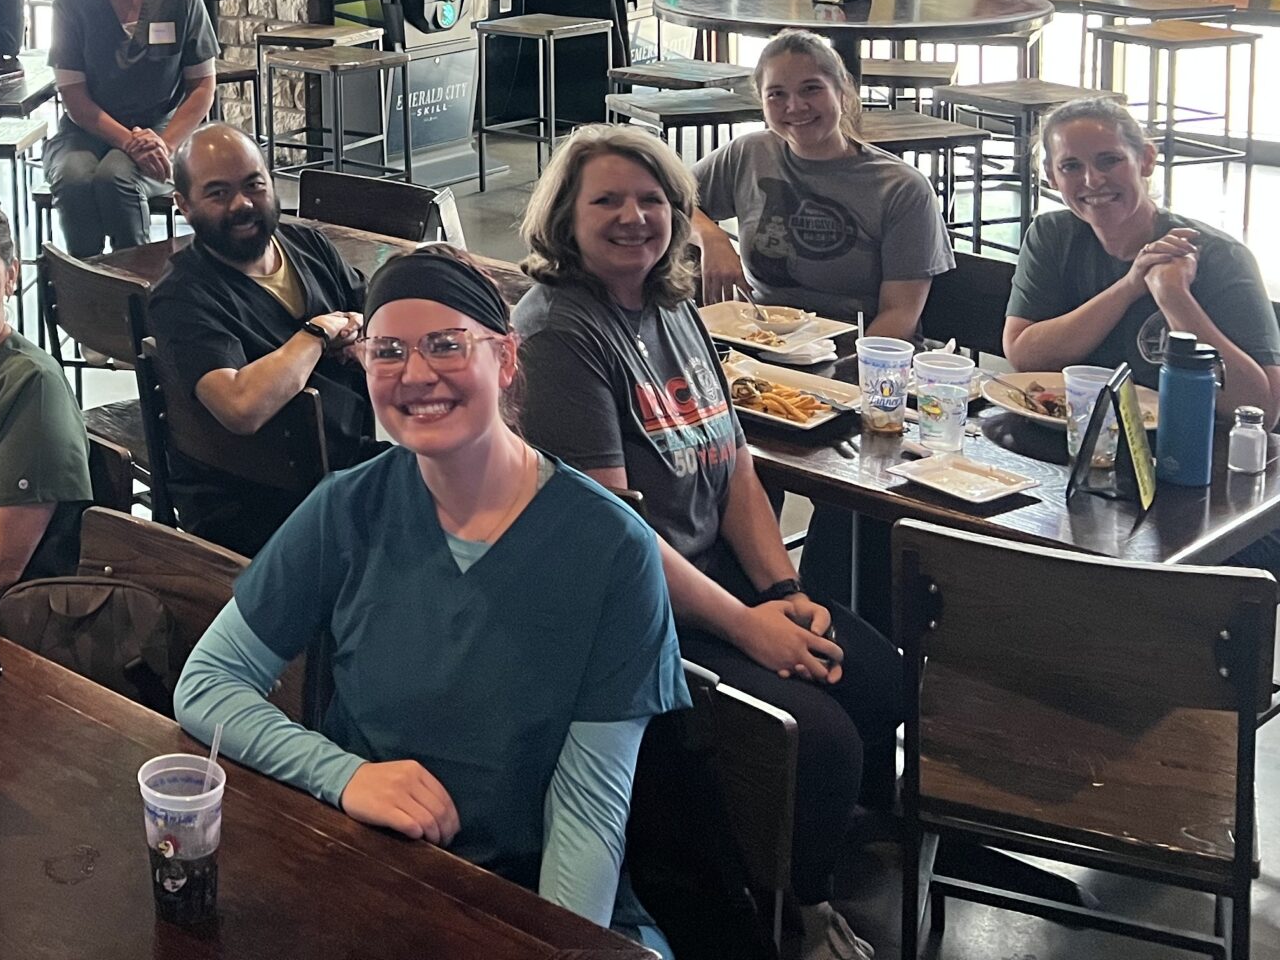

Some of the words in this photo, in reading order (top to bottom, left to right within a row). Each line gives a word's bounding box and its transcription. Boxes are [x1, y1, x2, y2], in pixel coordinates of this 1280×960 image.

[445, 81, 468, 101] CITY
[416, 103, 448, 117] SKILL
[674, 447, 698, 477] 50
